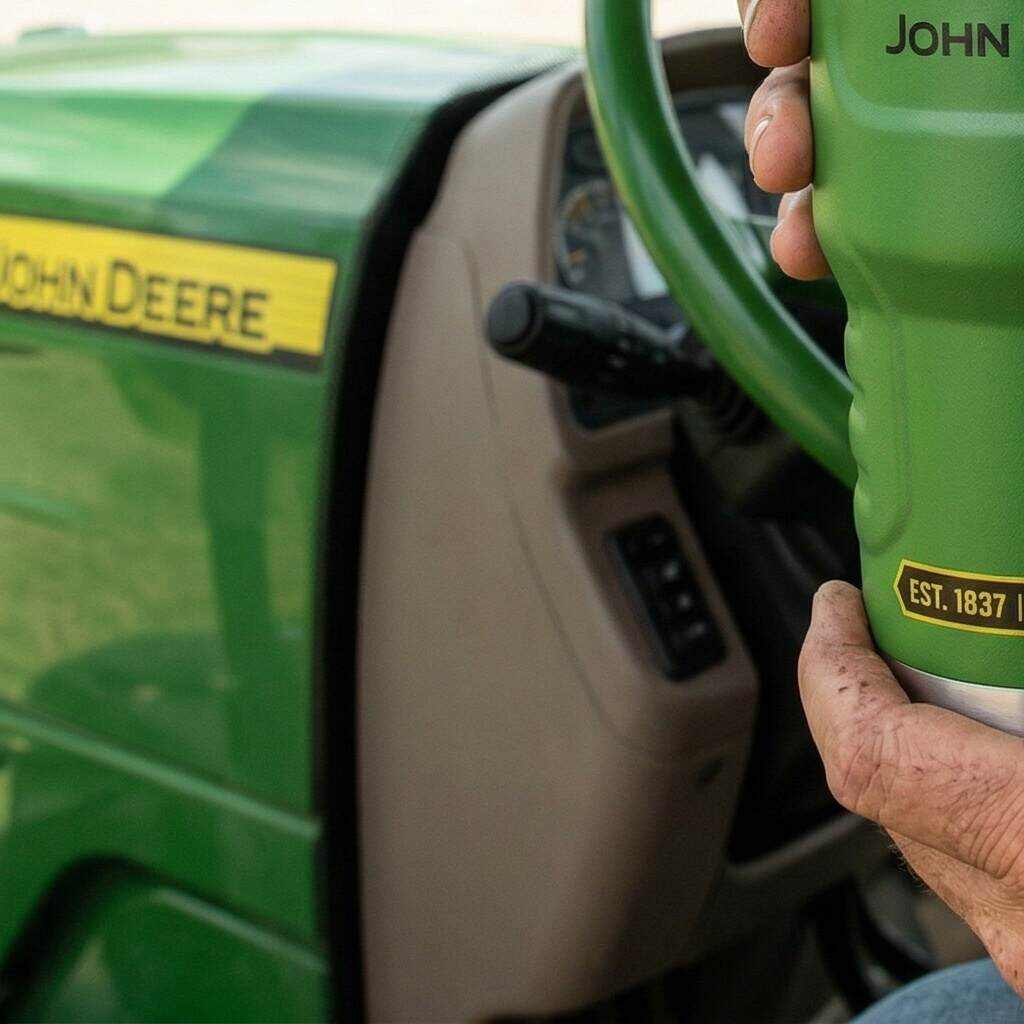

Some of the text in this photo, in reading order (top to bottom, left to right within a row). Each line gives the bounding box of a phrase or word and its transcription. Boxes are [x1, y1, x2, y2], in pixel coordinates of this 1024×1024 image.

[886, 14, 1010, 57] JOHN
[107, 259, 268, 338] DEERE
[909, 578, 948, 611] EST.
[954, 588, 1006, 618] 1837
